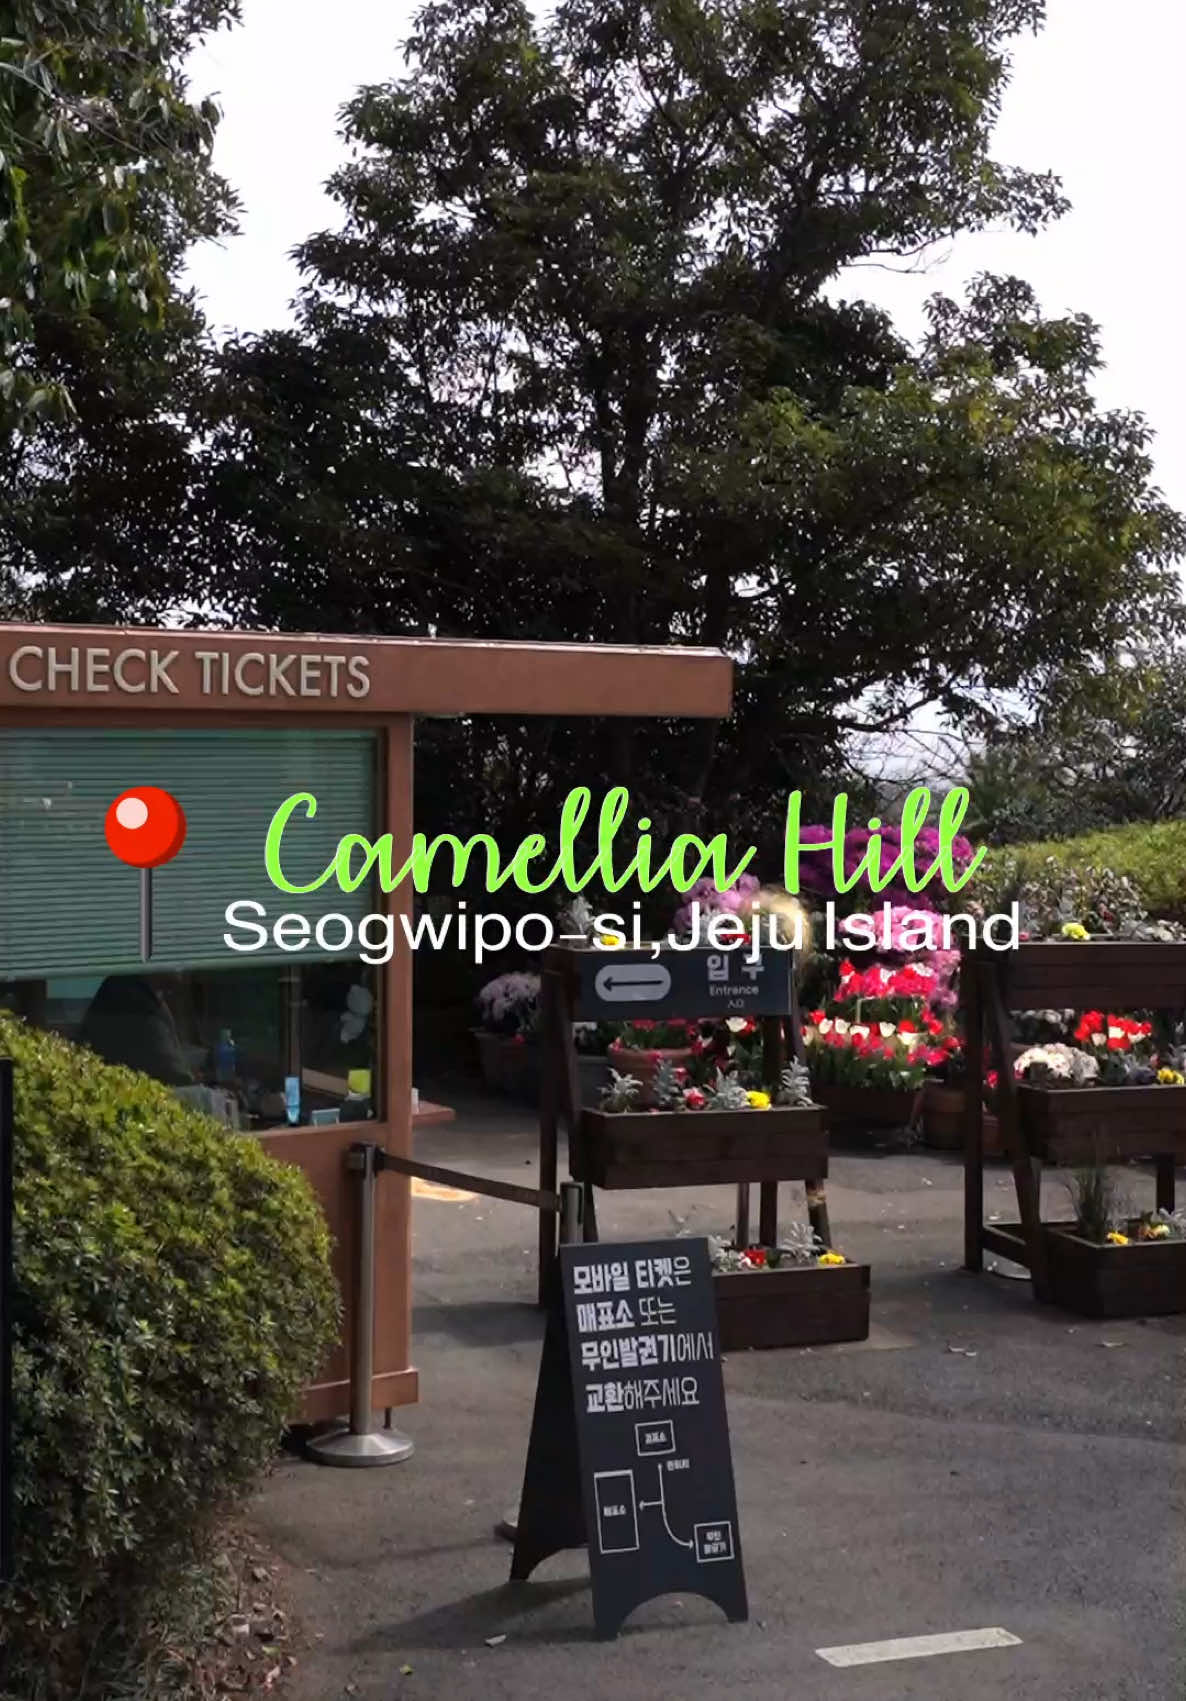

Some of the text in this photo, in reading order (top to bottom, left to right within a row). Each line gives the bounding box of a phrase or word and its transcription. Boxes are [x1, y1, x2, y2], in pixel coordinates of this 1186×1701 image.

[9, 645, 371, 698] CHECK TICKETS
[709, 985, 759, 997] Entrance
[573, 1256, 692, 1295] 모바일 티켓은
[576, 1296, 677, 1333] 매표소 또는
[581, 1331, 714, 1371] 무인발권기에서
[585, 1376, 700, 1413] 교환해주세요
